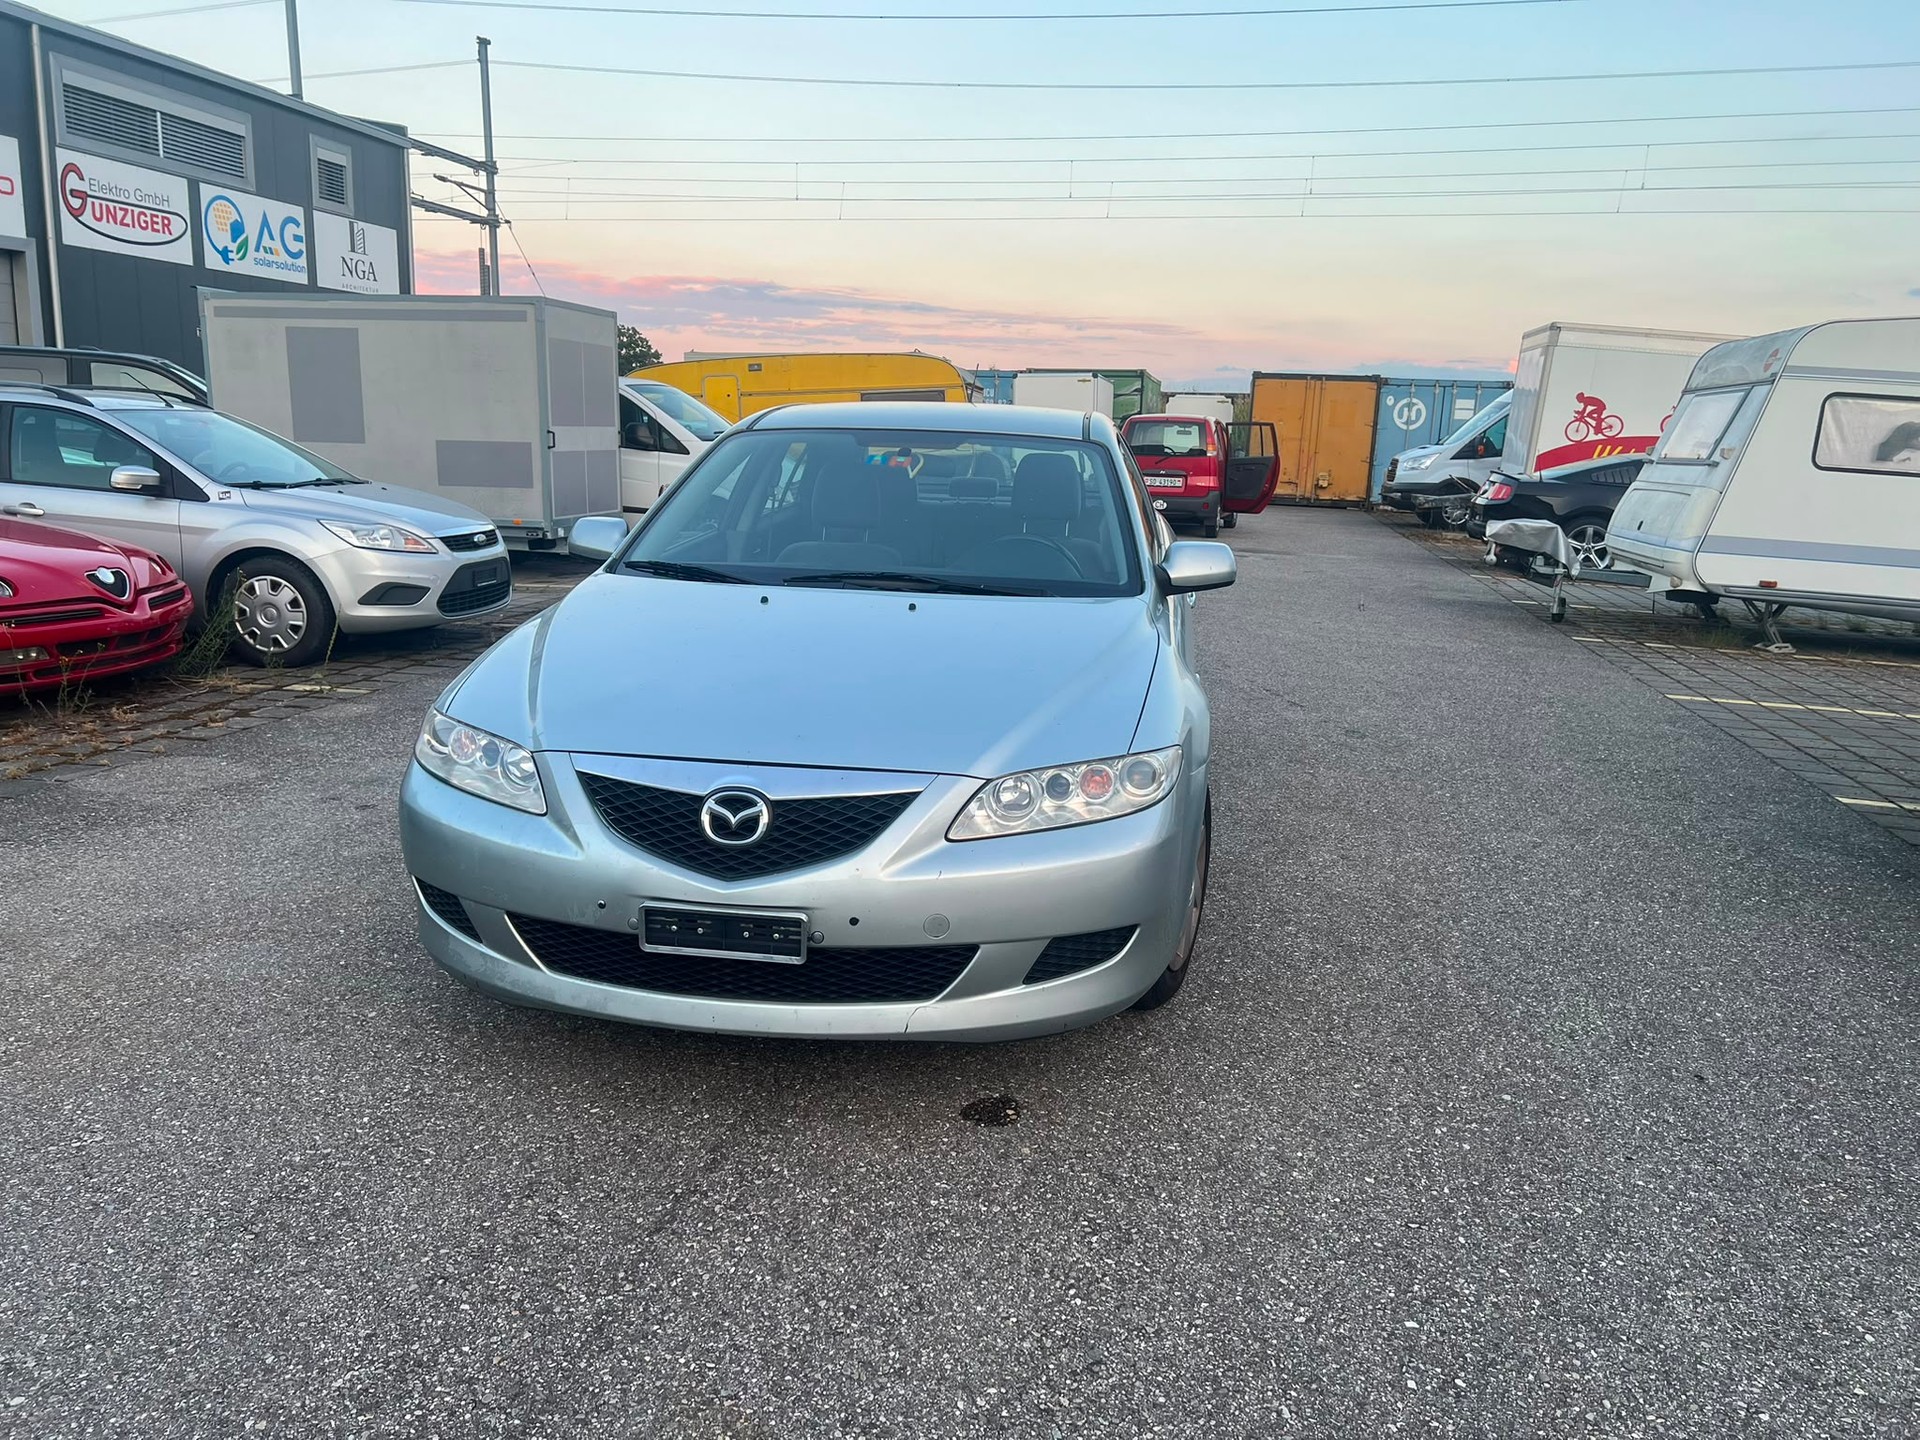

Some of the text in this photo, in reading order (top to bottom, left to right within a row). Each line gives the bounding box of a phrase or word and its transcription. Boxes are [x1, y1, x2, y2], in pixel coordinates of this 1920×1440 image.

[88, 178, 171, 208] Elektro GmbH
[253, 256, 307, 275] solarsolution
[341, 255, 378, 282] NGA
[1154, 501, 1165, 509] CH
